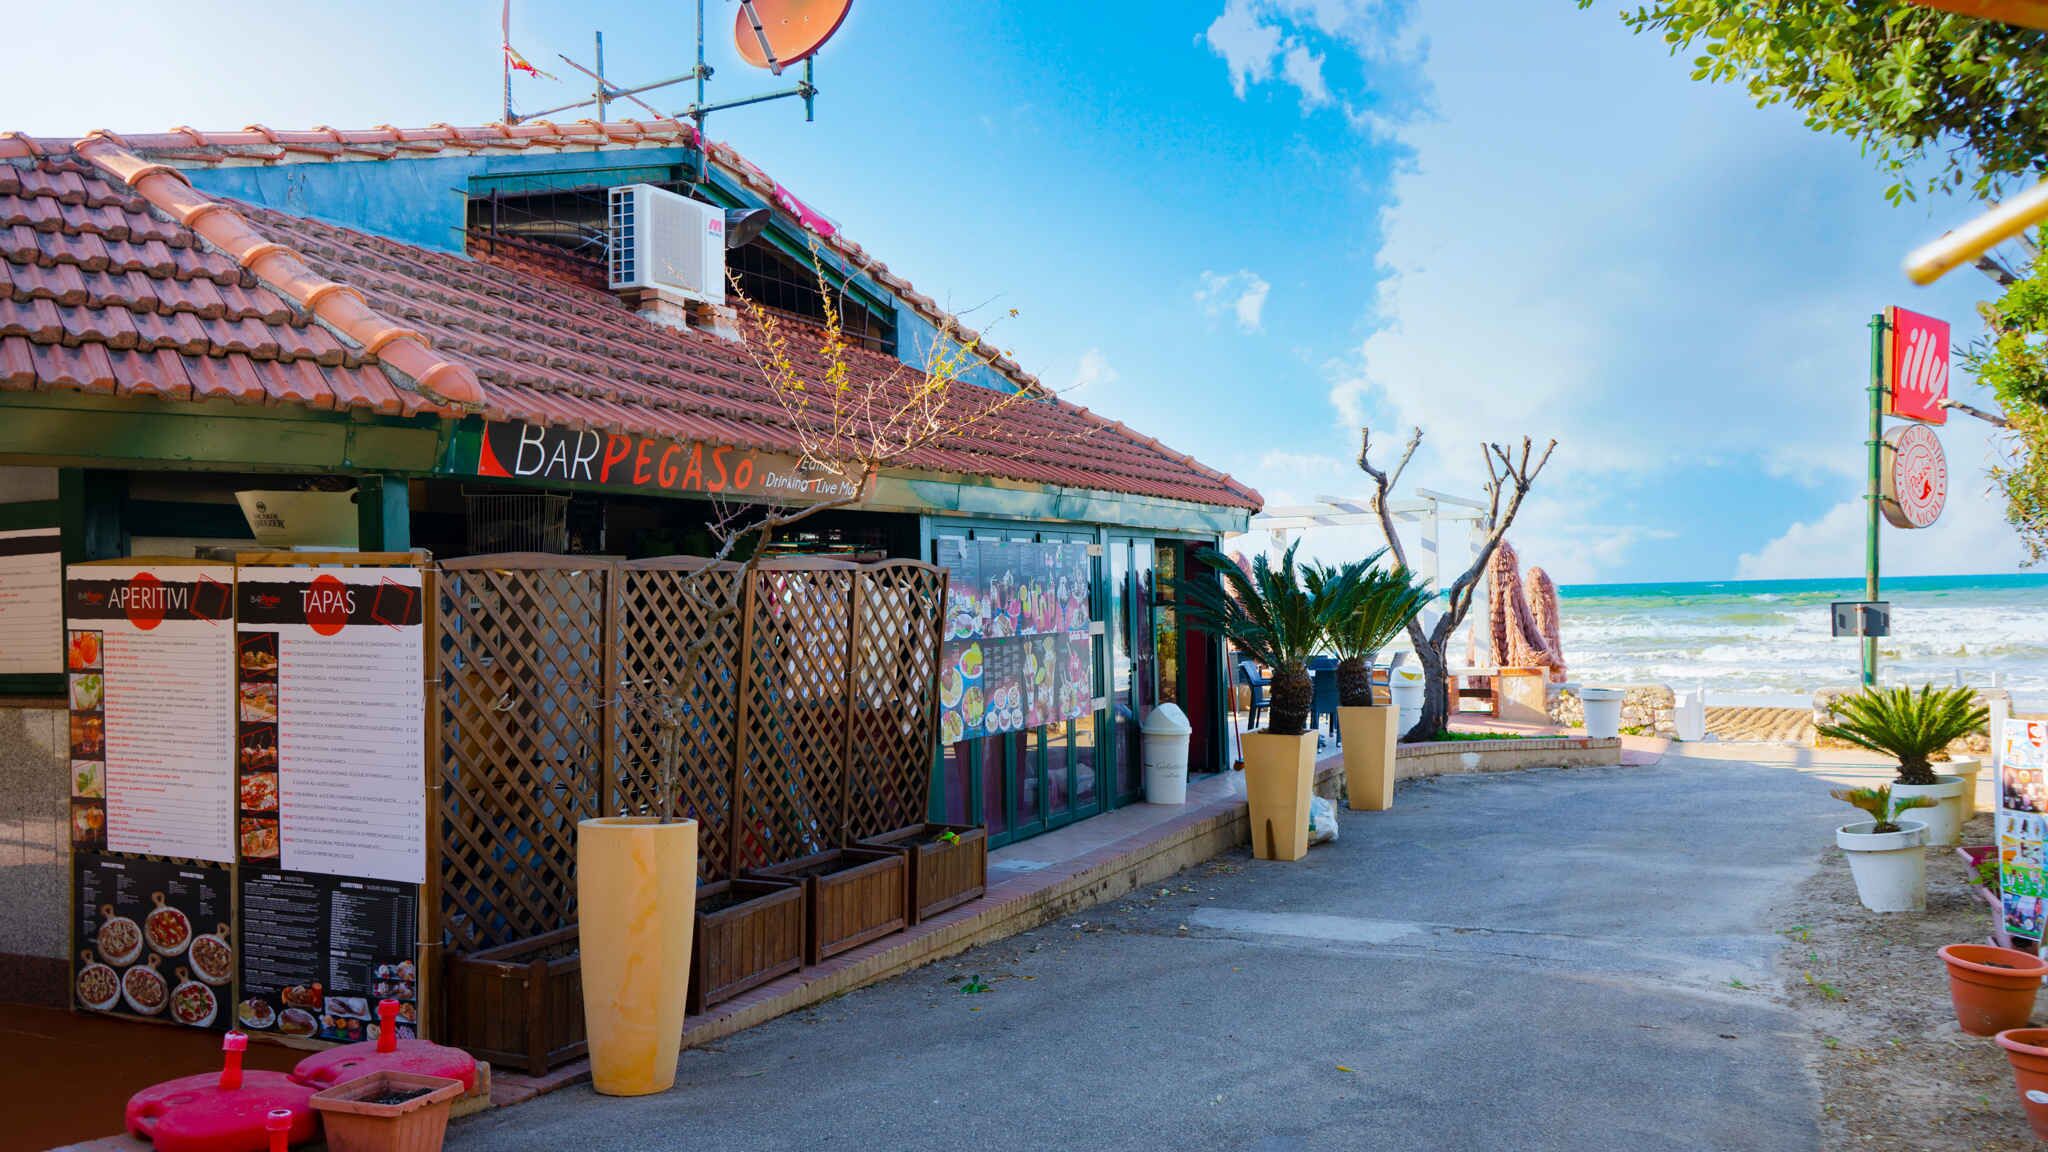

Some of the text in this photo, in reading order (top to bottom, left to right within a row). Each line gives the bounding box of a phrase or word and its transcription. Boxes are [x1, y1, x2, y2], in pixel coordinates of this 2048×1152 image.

[1900, 328, 1947, 410] illy
[514, 423, 758, 492] BAR PEGASO
[765, 472, 809, 493] Drinking
[816, 480, 837, 494] Live
[108, 587, 188, 610] APERITIVI
[299, 590, 356, 615] TAPAS
